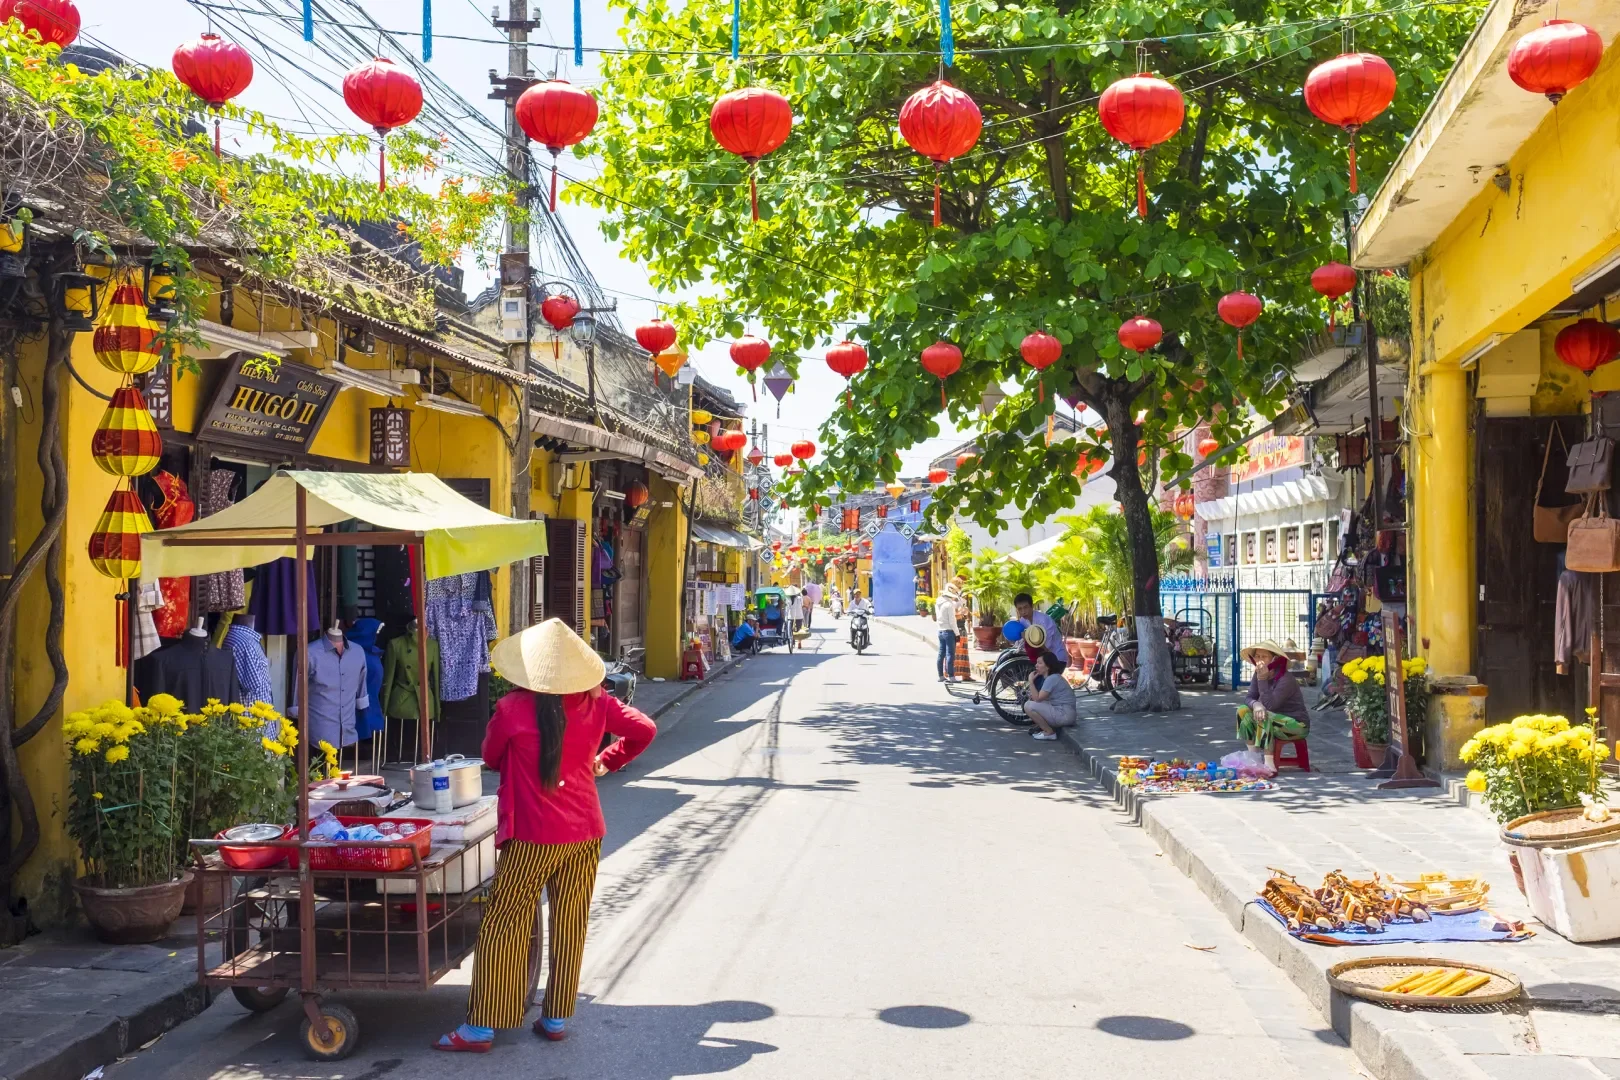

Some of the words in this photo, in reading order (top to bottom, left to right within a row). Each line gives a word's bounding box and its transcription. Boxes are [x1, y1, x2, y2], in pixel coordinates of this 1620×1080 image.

[297, 379, 314, 394] Cloth
[312, 384, 328, 400] Shop
[230, 385, 299, 420] HUGÔ
[297, 402, 319, 425] II
